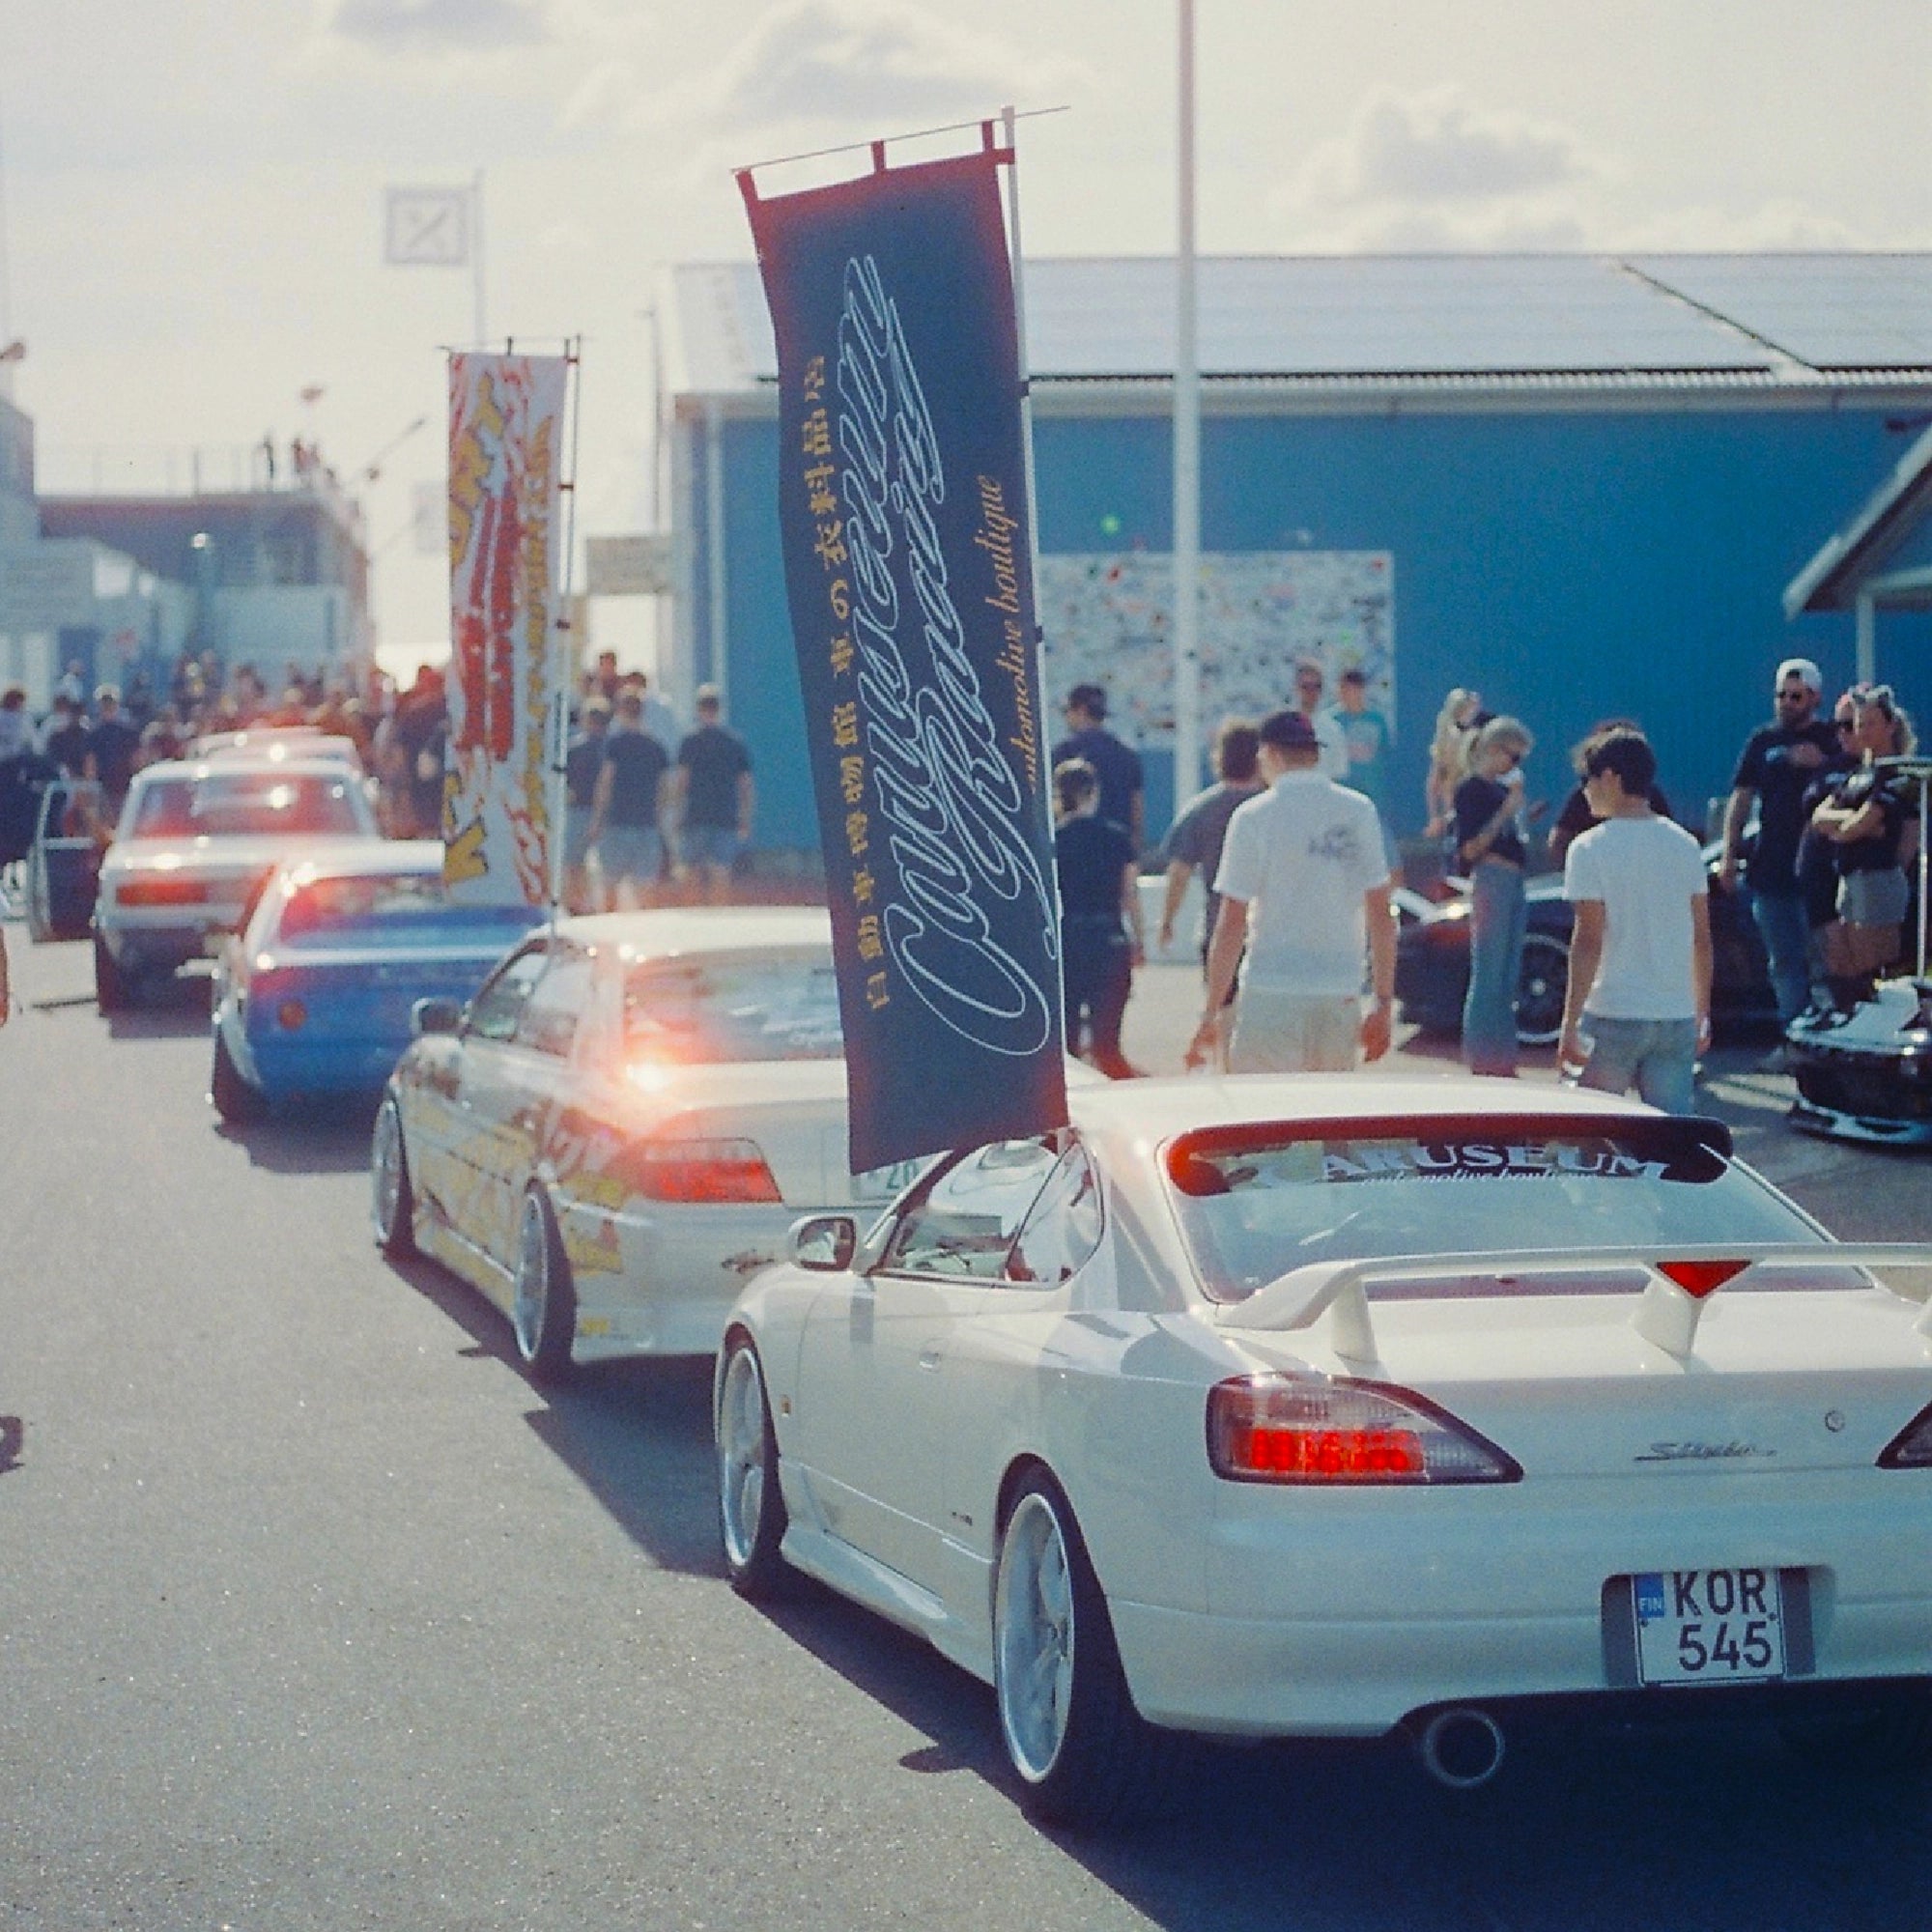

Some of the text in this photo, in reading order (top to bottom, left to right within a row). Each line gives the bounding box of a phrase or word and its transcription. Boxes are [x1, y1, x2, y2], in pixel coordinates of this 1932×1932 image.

[974, 474, 1019, 613] boutique
[1638, 1597, 1663, 1614] FIN
[1672, 1568, 1767, 1618] KOR
[1678, 1621, 1772, 1672] 545
